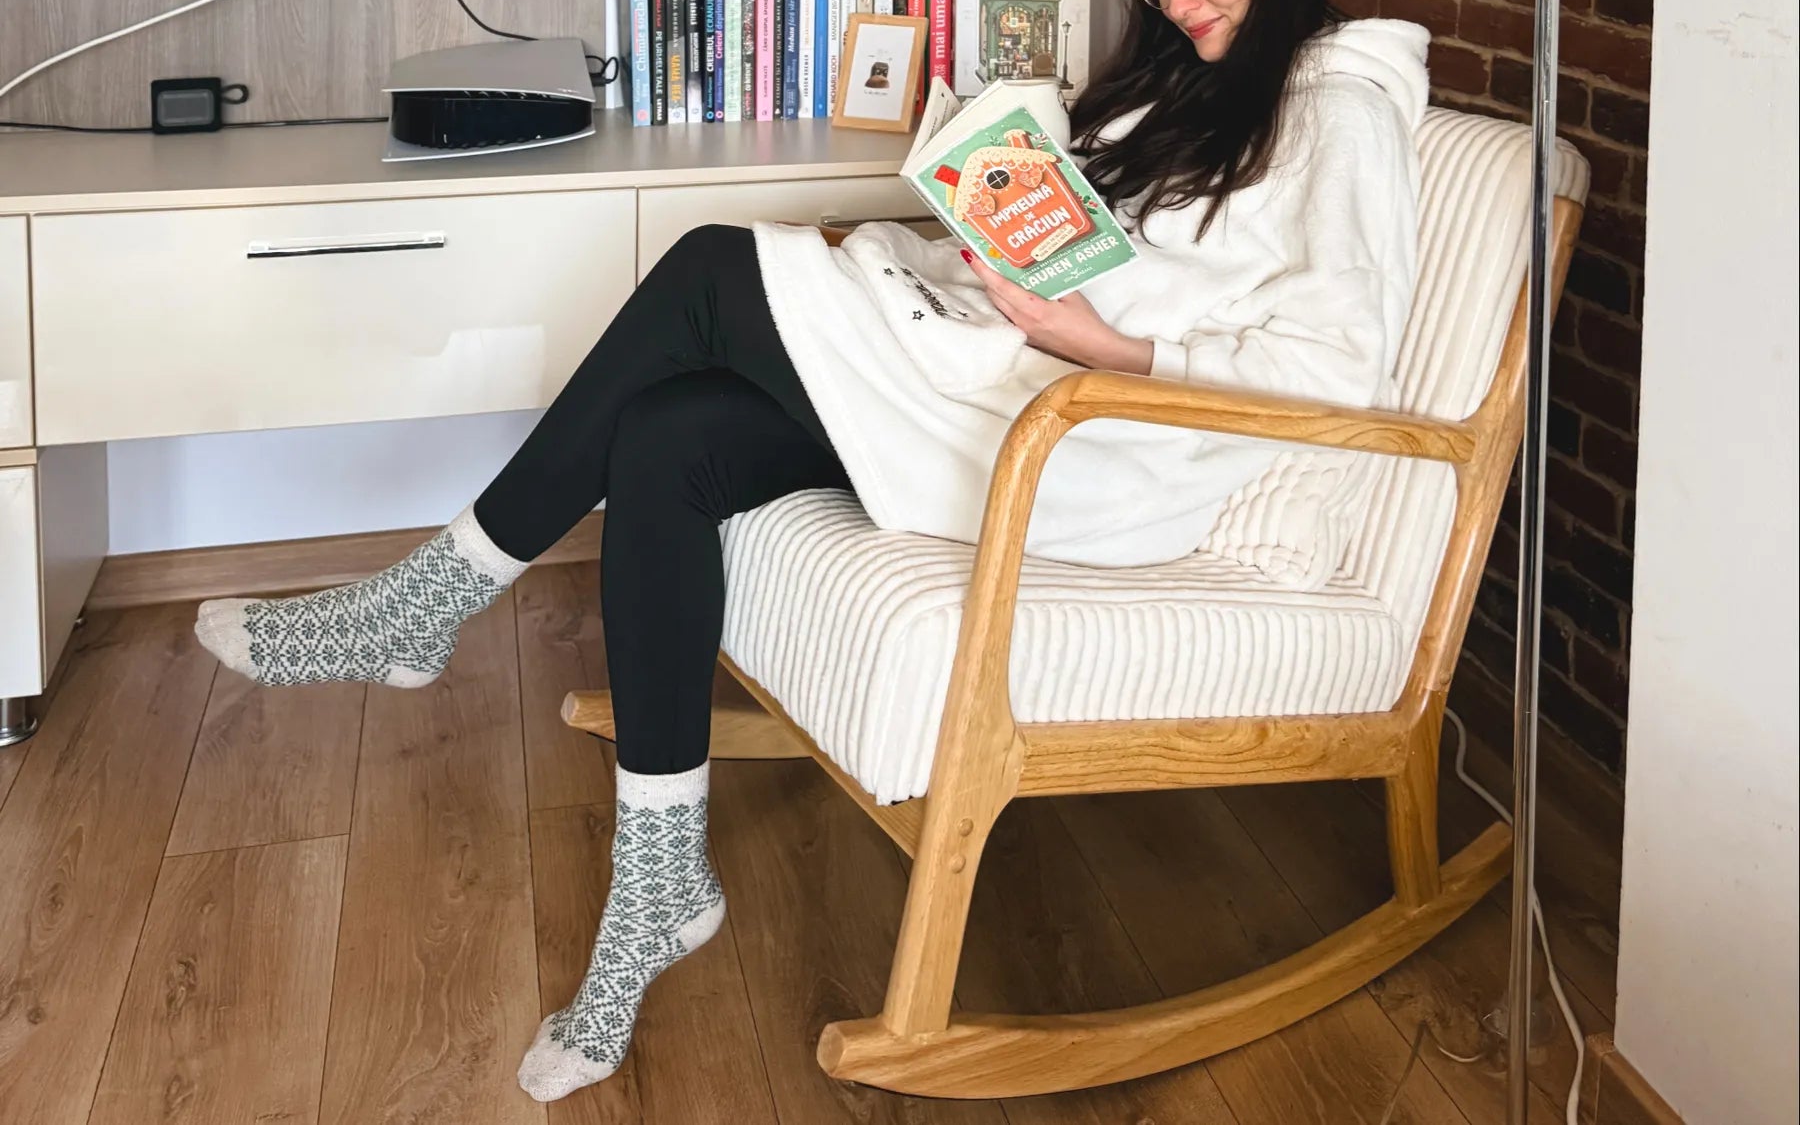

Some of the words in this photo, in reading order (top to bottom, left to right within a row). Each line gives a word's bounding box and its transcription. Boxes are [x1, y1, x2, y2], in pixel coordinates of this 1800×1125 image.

[636, 33, 647, 71] Chimie
[656, 31, 663, 41] PE
[715, 31, 723, 59] Creierul
[932, 32, 945, 58] mai
[706, 35, 714, 72] CREIERUL
[1006, 206, 1072, 249] CRĂCIUN
[1024, 211, 1036, 221] DE
[1020, 260, 1073, 290] LAUREN
[1075, 235, 1119, 264] ASHER
